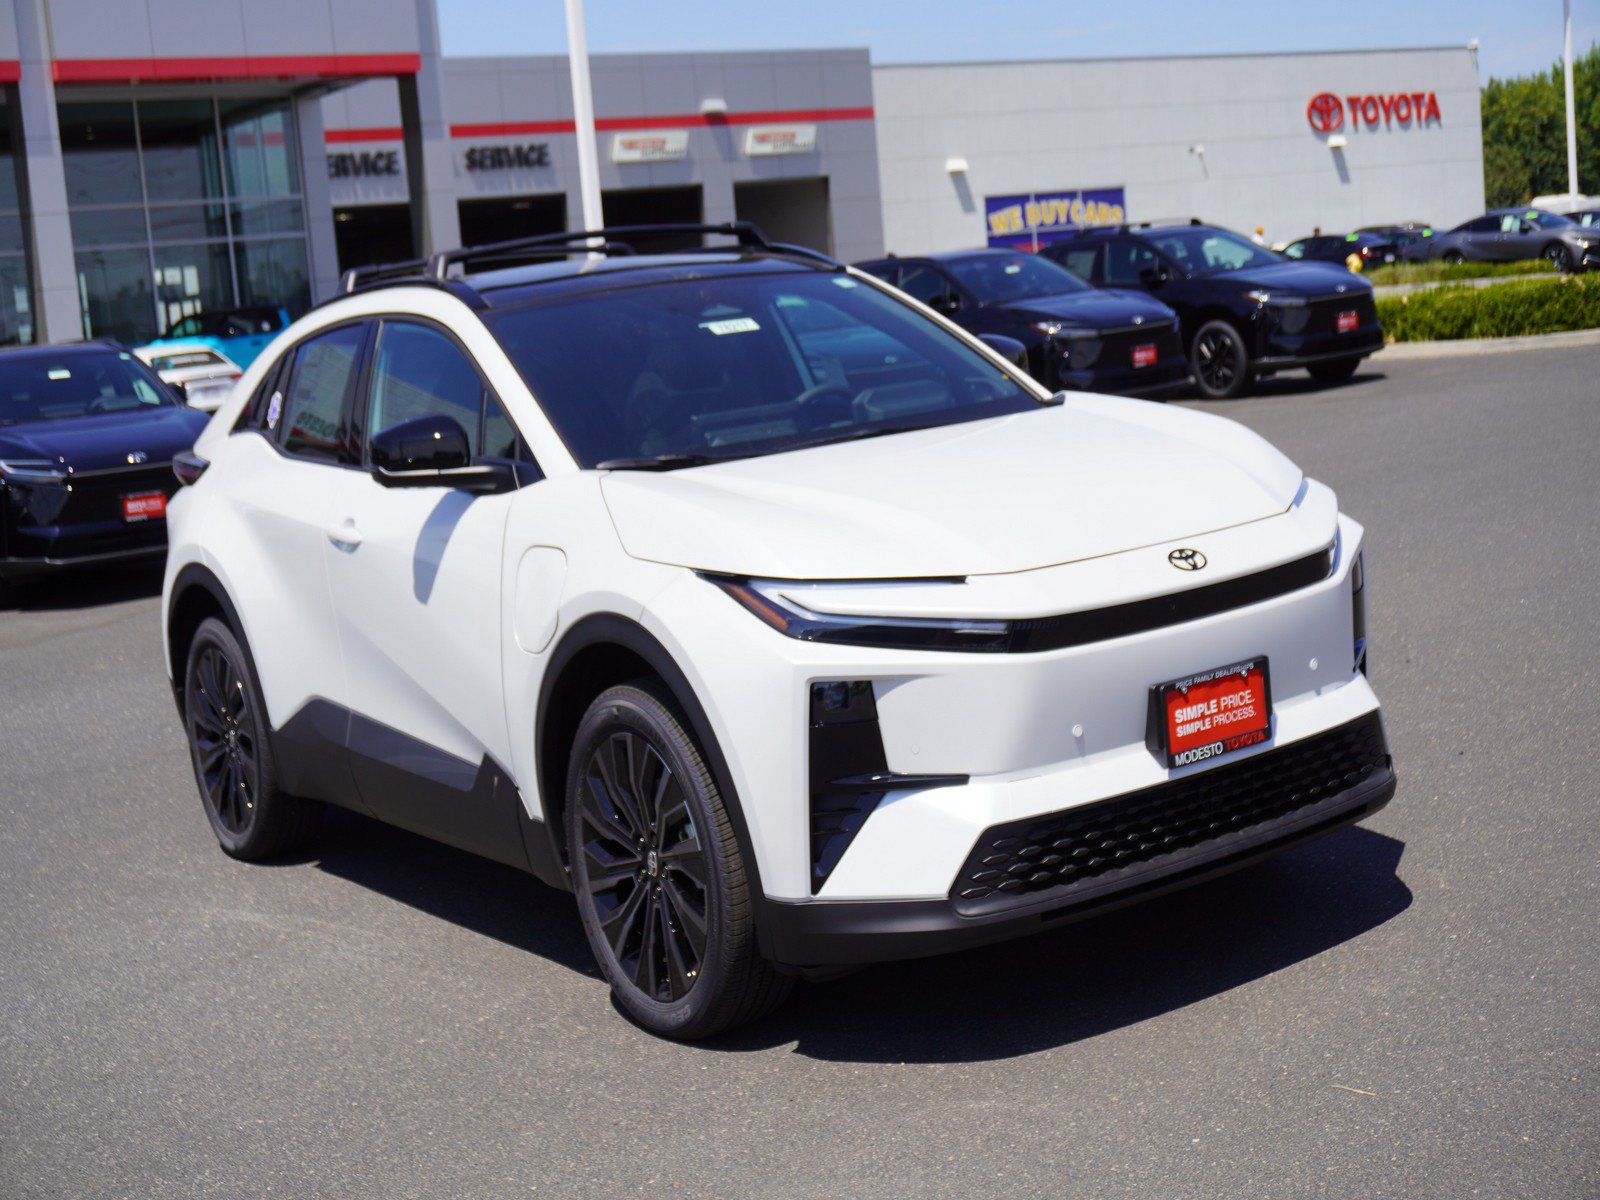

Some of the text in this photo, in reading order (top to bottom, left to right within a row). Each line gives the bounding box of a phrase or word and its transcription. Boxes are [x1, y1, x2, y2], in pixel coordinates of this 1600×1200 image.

[1346, 91, 1441, 124] TOYOTA
[327, 151, 399, 178] ERVICE
[465, 144, 549, 170] SERVICE
[989, 200, 1124, 237] WE BUY CARS
[1175, 662, 1254, 690] PRICE FAMILY DEALERSHIPS
[1174, 689, 1255, 723] SIMPLE PRICE.
[1176, 705, 1256, 738] SIMPLE PROCESS.
[1175, 731, 1265, 766] MODESTO TOYOTA
